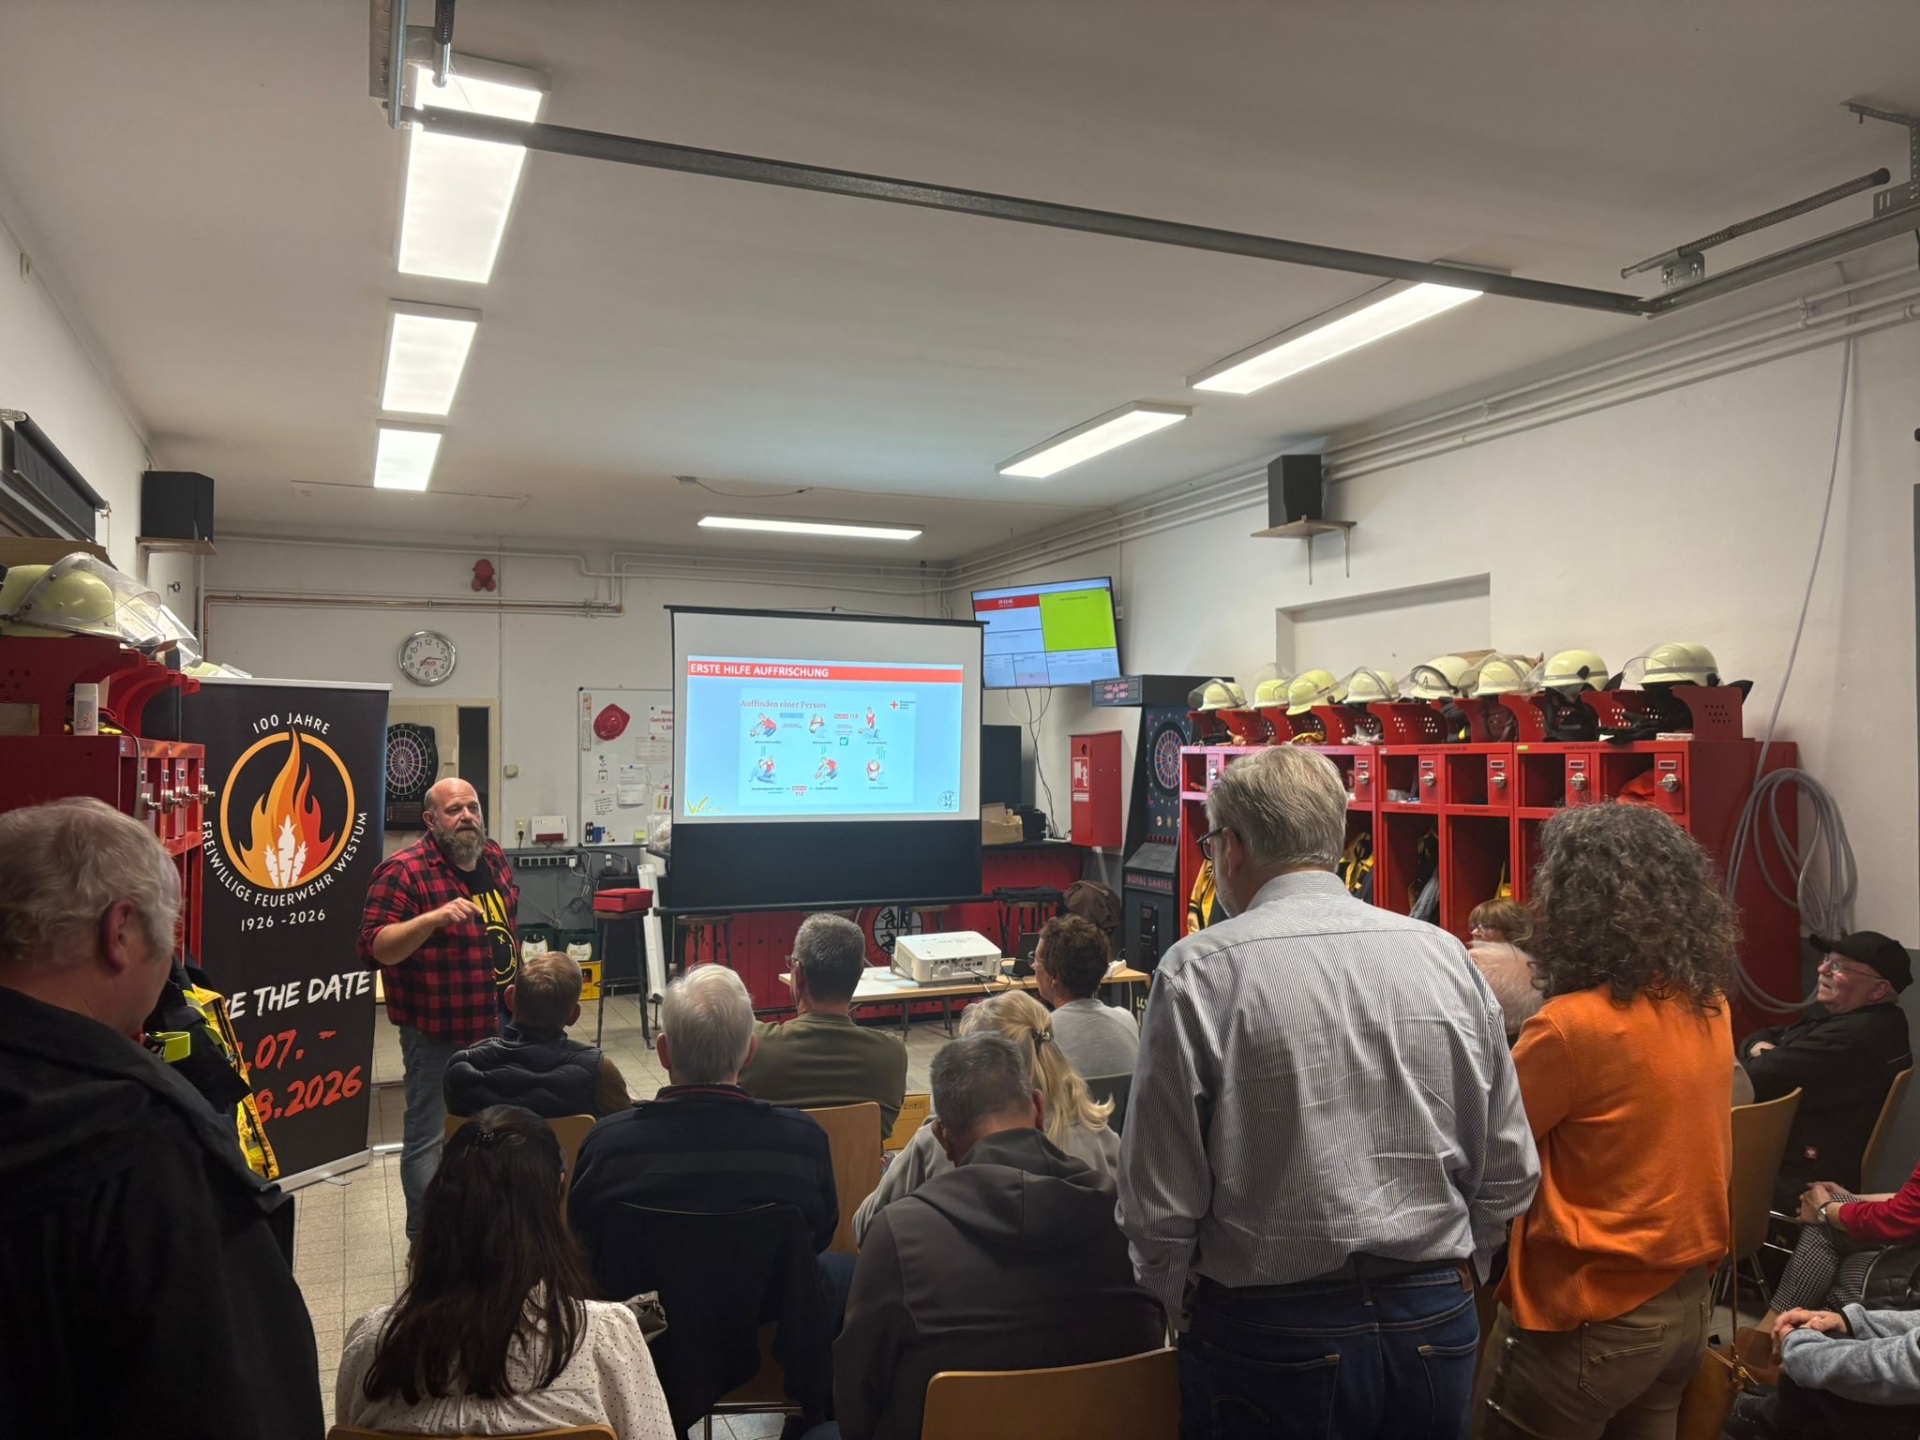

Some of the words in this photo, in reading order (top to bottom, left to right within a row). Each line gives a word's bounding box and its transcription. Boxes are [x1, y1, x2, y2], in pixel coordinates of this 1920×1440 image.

[406, 653, 413, 661] 9
[433, 668, 439, 676] 5
[689, 663, 721, 675] ERSTE
[723, 664, 751, 676] HILFE
[753, 666, 830, 678] AUFFRISCHUNG
[740, 699, 779, 709] Auffinden
[780, 700, 799, 709] einer
[800, 701, 826, 709] Person
[252, 714, 279, 734] 100
[286, 712, 331, 735] JAHRE
[201, 820, 252, 903] FREIWILLIGE
[254, 874, 335, 908] FEUERWEHR
[333, 811, 368, 874] WESTUM
[241, 913, 274, 932] 1926
[253, 981, 300, 1017] THE
[307, 970, 371, 1004] DATE
